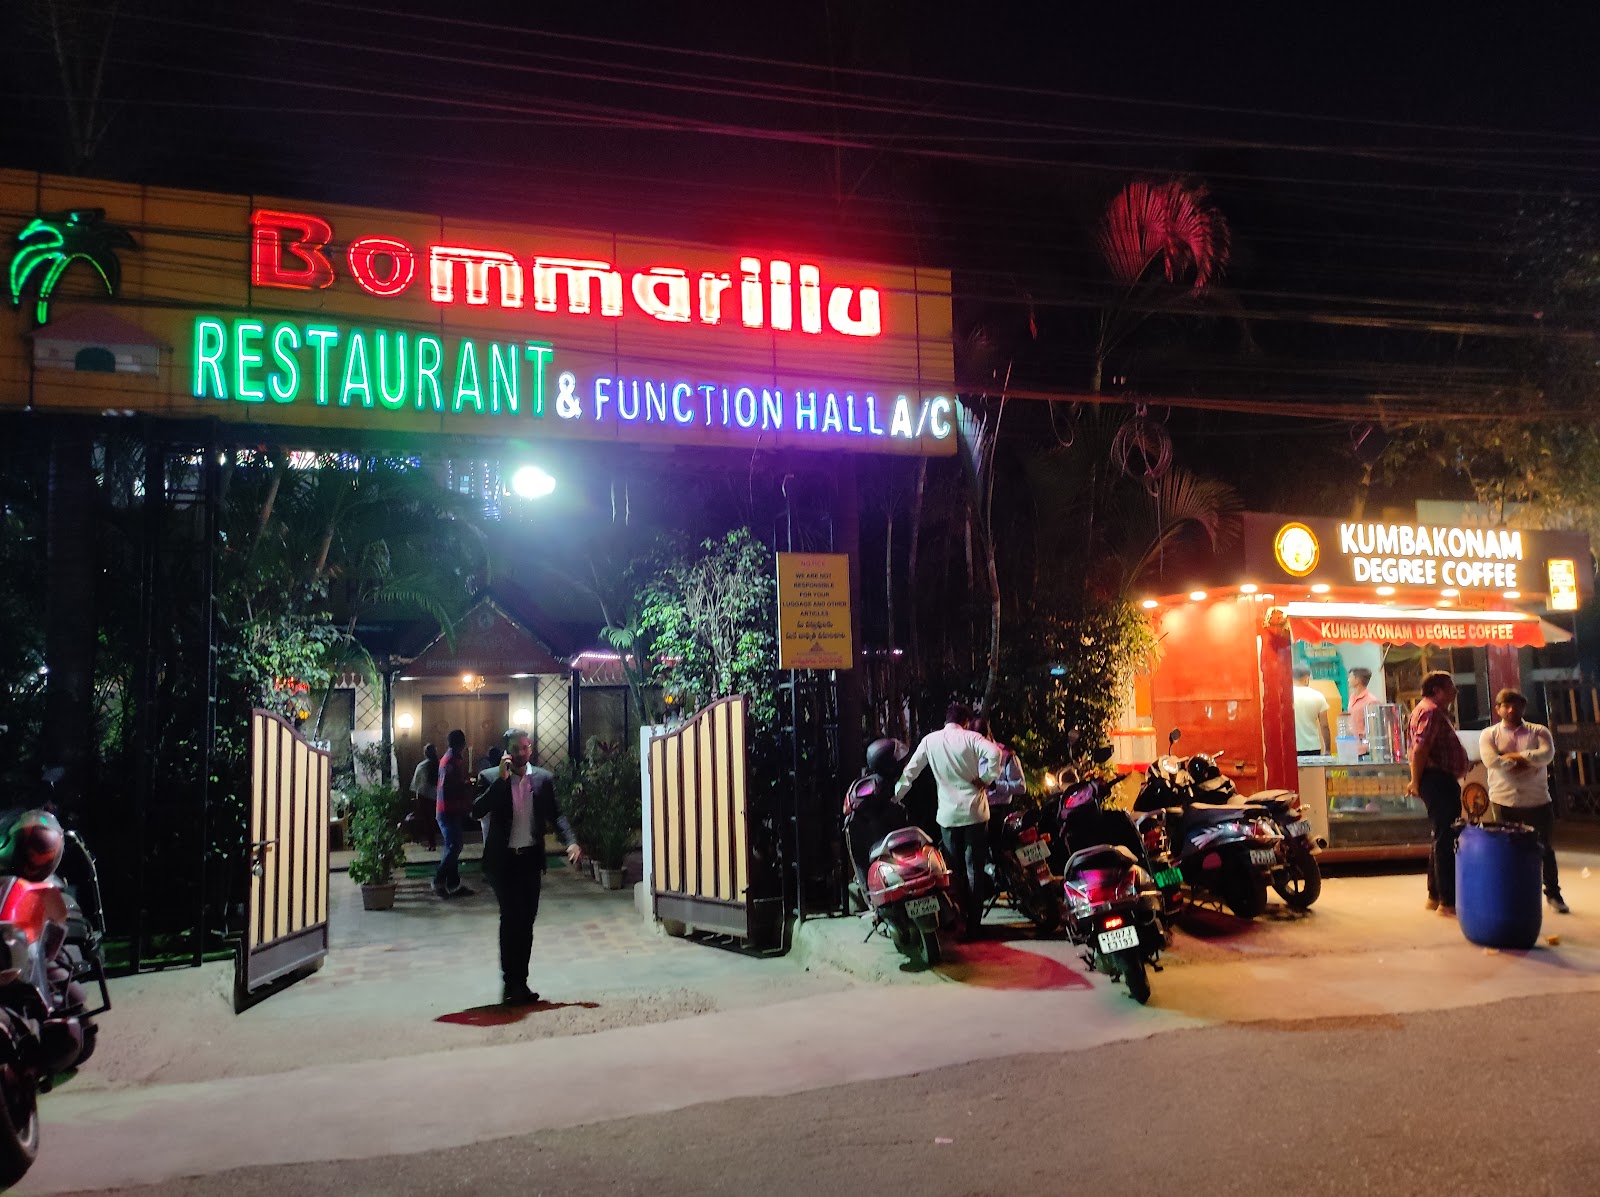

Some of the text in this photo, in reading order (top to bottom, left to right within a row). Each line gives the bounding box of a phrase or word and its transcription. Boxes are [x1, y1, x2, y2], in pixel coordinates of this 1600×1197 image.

[251, 209, 882, 337] Bommarillu
[193, 315, 952, 440] RESTAURANT & FUNCTION HALL A/C
[1340, 523, 1523, 560] KUMBAKONAM
[1354, 557, 1436, 585] DEGREE
[1442, 561, 1517, 588] COFFEE
[1321, 621, 1514, 640] KUMBAKONAM DEGREE COFFEE
